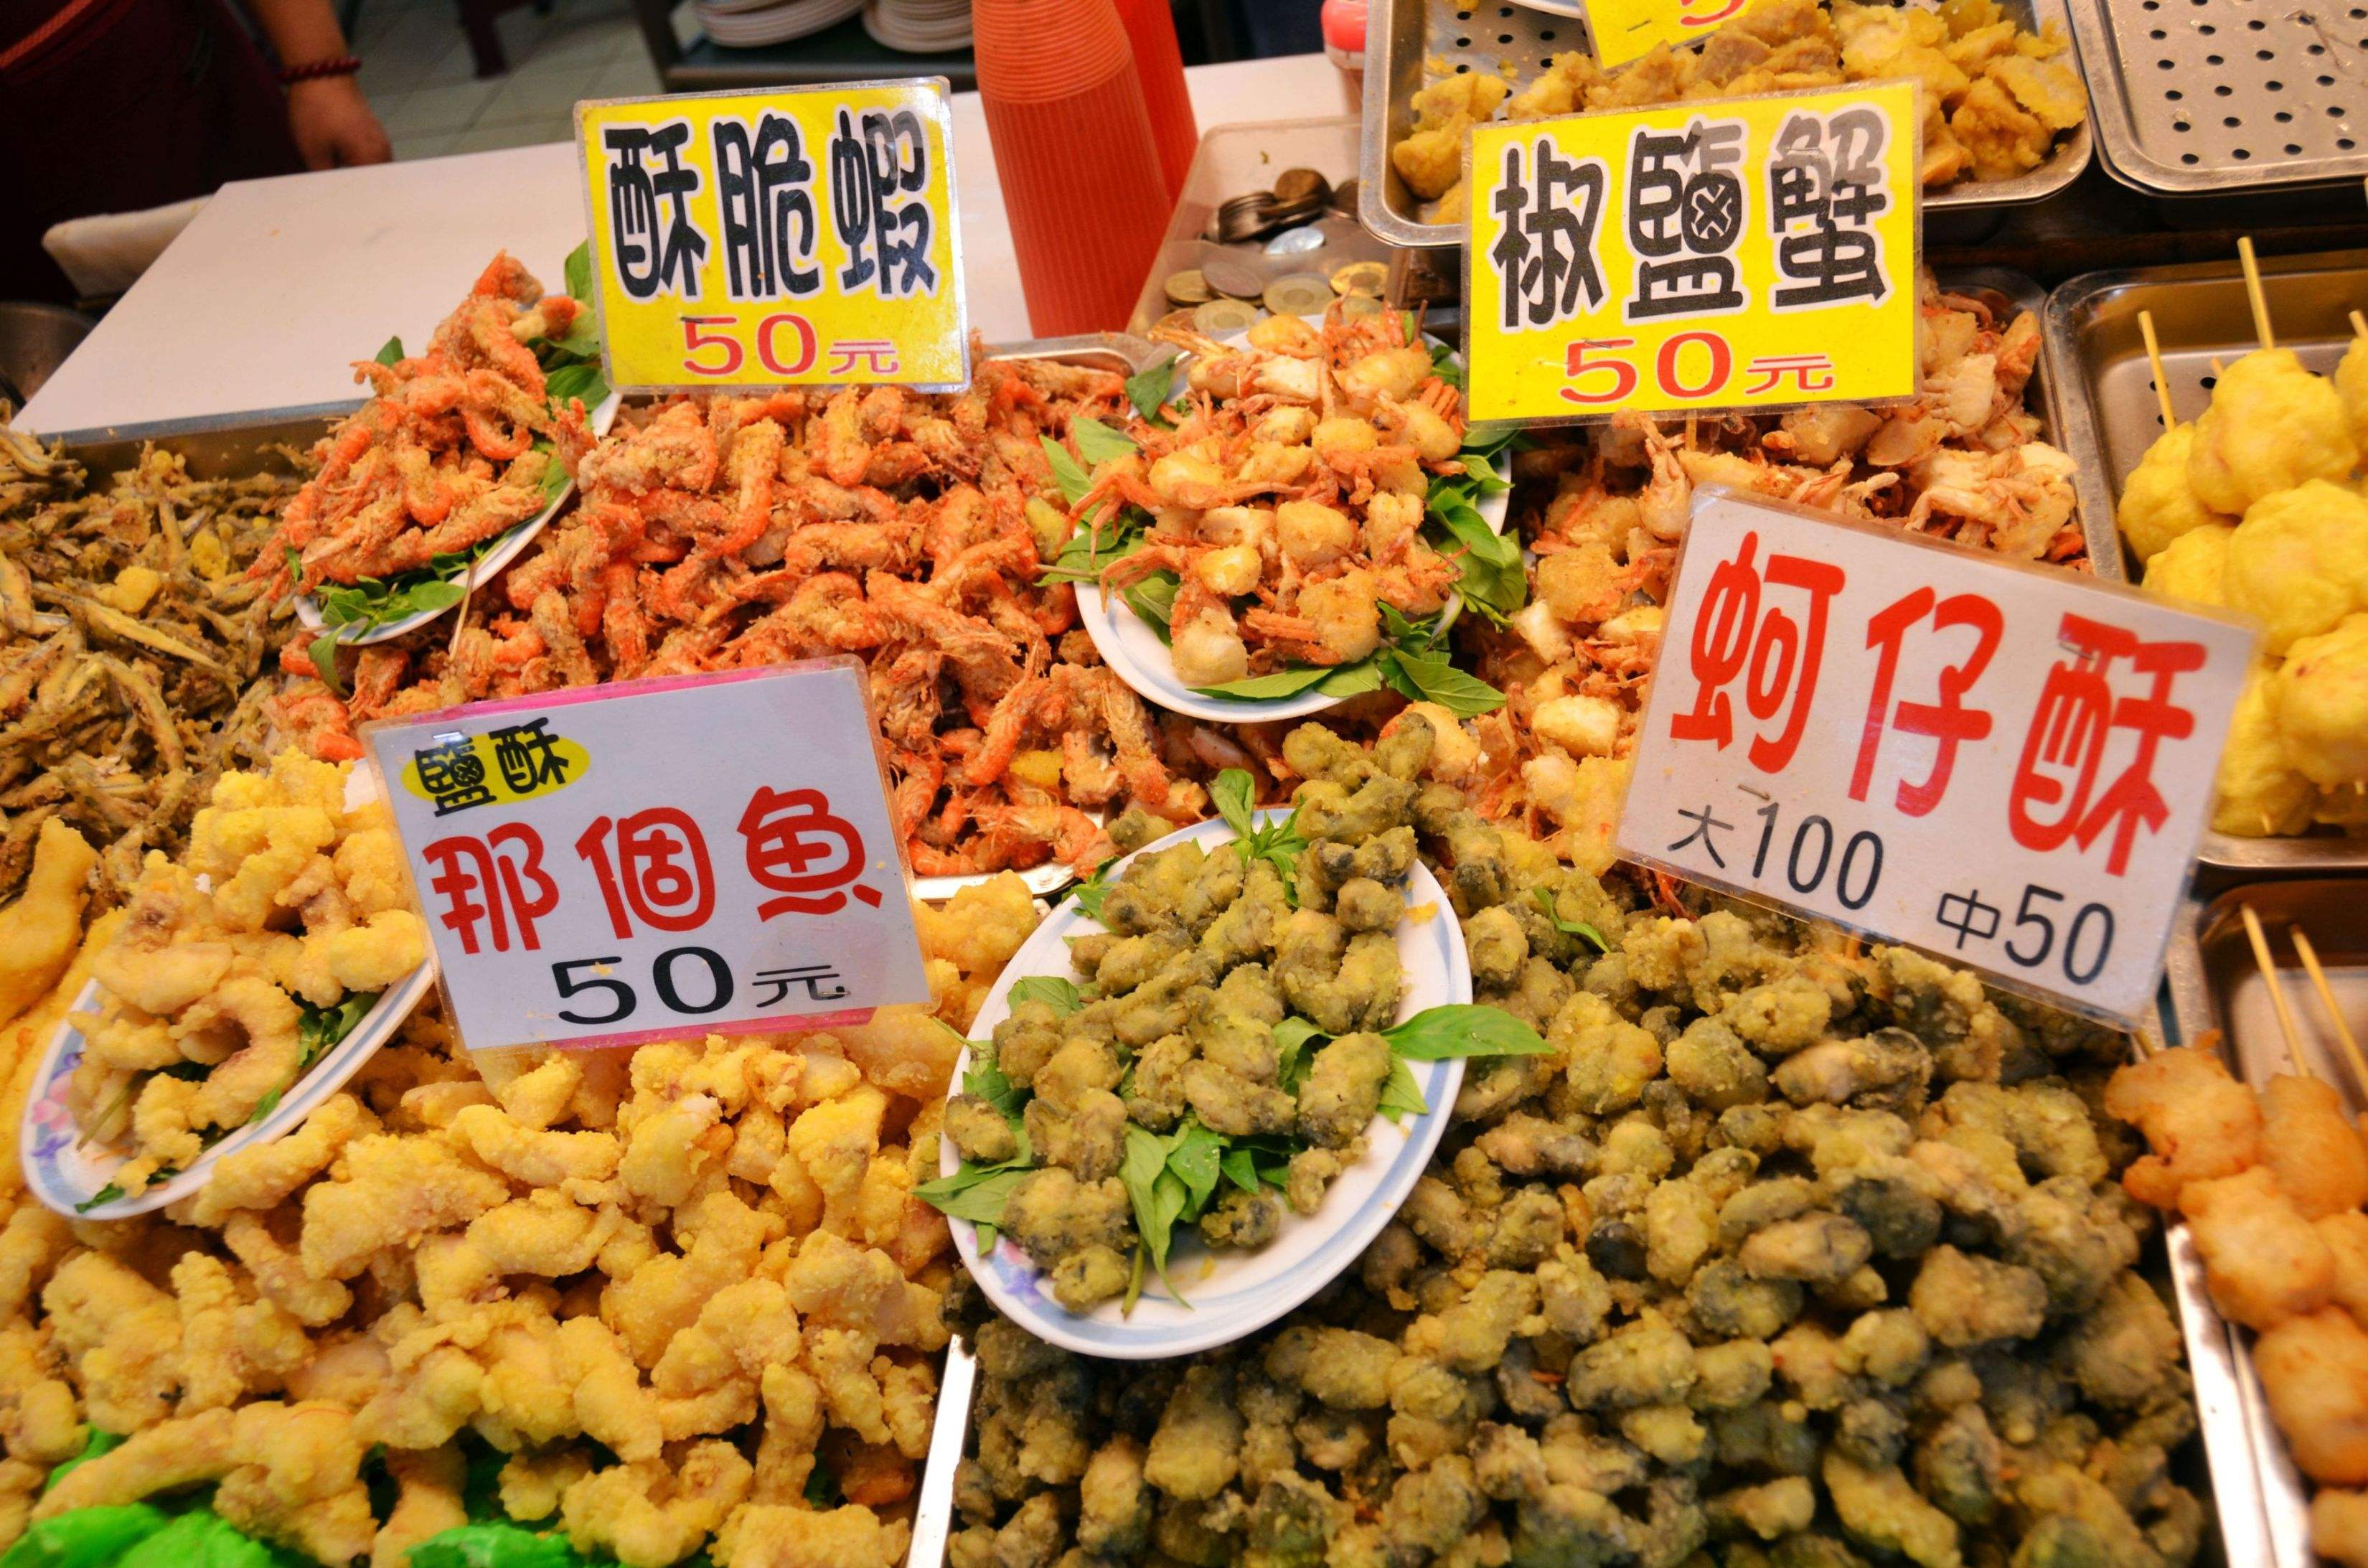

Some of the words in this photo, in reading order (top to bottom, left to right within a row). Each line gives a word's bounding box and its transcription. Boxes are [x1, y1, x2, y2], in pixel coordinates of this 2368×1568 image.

[604, 111, 935, 297] 酥脆蝦
[1492, 108, 1887, 328] 椒鹽蟹
[681, 314, 898, 375] 50元
[1560, 332, 1833, 403] 50元
[414, 717, 570, 817] 鹽酥
[1671, 530, 2207, 878] 蚵仔酥
[422, 786, 883, 955] 那個魚
[551, 946, 851, 1025] 50元
